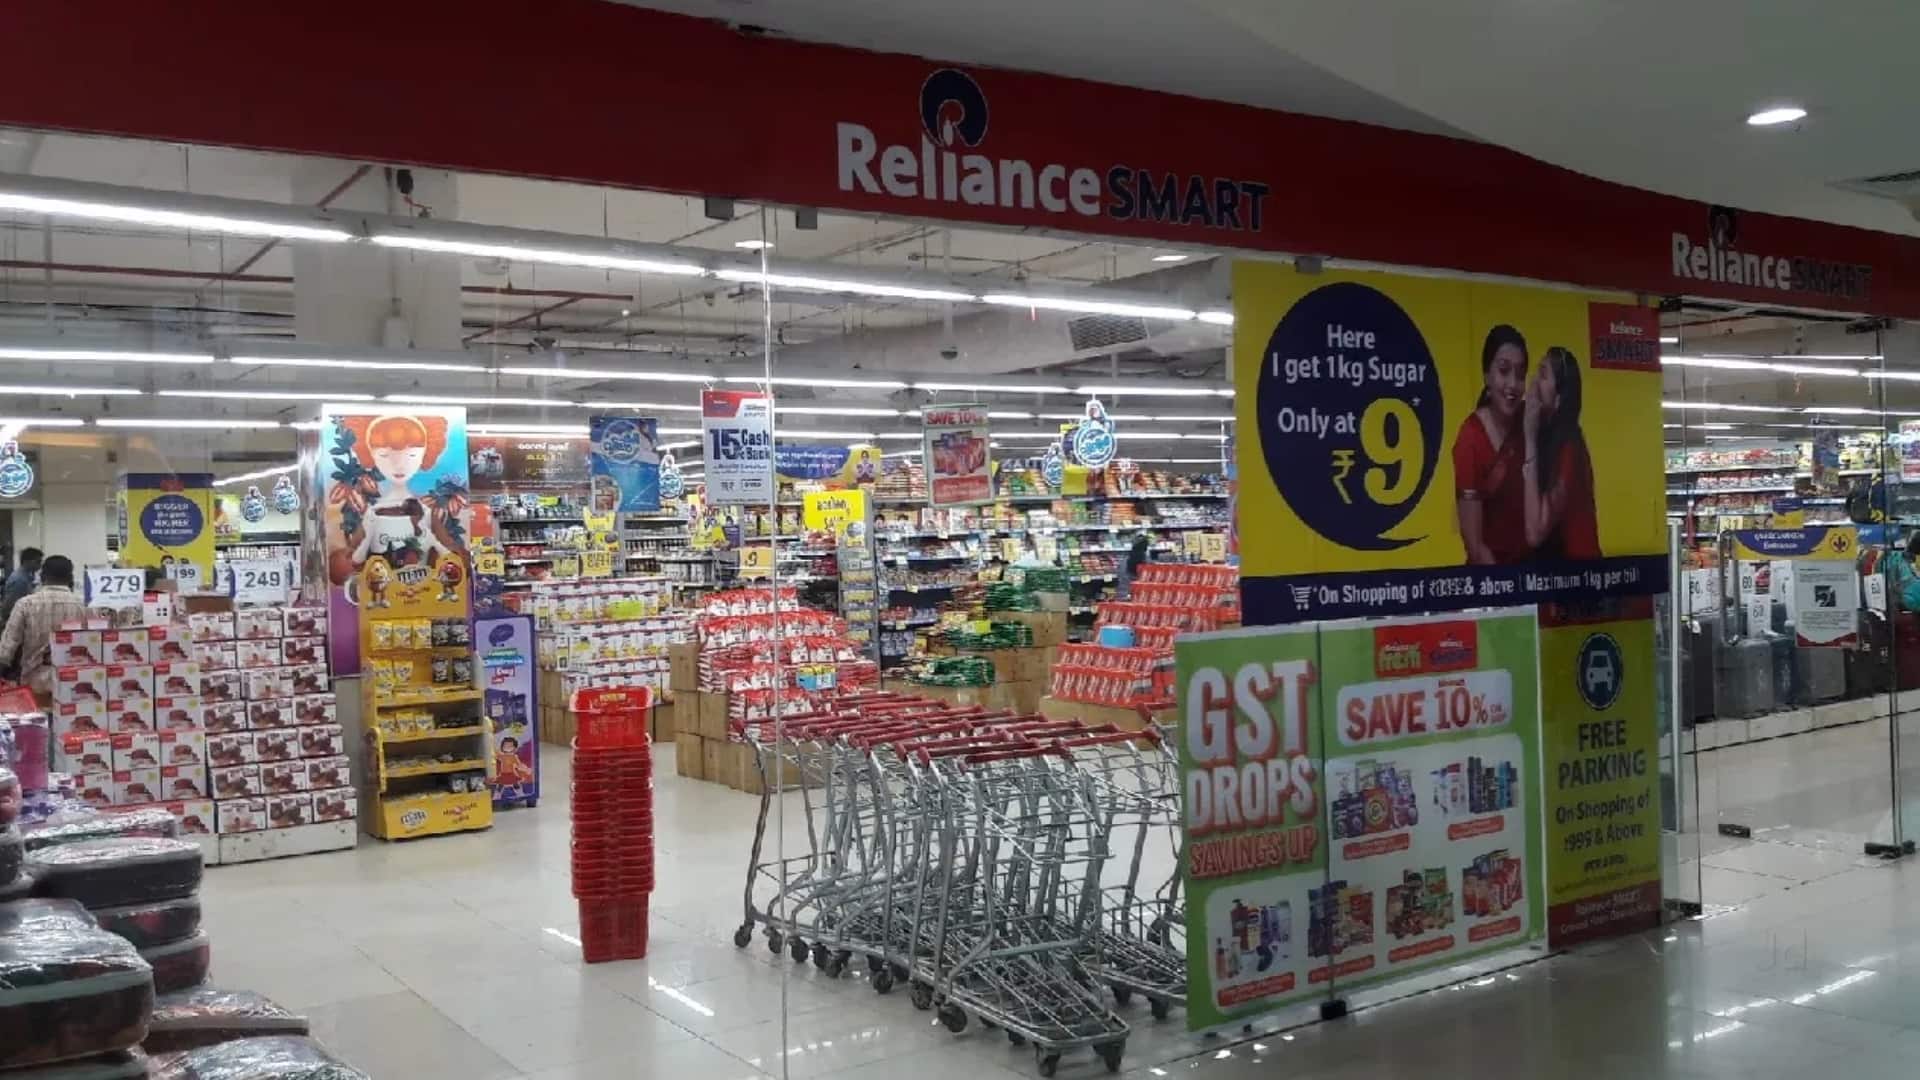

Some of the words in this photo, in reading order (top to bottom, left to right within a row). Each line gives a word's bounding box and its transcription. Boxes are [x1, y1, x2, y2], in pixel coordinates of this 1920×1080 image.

[836, 121, 1101, 215] Reliance
[1107, 165, 1270, 232] SMART
[1672, 232, 1791, 290] Reliance
[1327, 324, 1375, 349] Here
[1272, 353, 1278, 377] I
[1285, 357, 1320, 384] get
[1327, 355, 1364, 387] 1kg
[1368, 358, 1427, 387] Sugar
[741, 429, 769, 446] Cash
[1278, 408, 1331, 440] Only
[1334, 411, 1356, 434] at
[100, 574, 140, 593] 279
[245, 571, 280, 587] 249
[1319, 585, 1339, 605] On
[1343, 581, 1407, 607] Shopping
[1411, 581, 1425, 600] of
[1480, 576, 1515, 595] above
[1526, 573, 1581, 591] Maximum
[1584, 570, 1601, 591] 1kg
[1604, 571, 1622, 590] per
[1186, 660, 1313, 765] GST
[1347, 690, 1426, 740] SAVE
[1578, 720, 1626, 752] FREE
[1558, 749, 1646, 789] PARKING
[1186, 754, 1317, 835] DROPS
[1556, 806, 1574, 824] On
[1577, 792, 1635, 821] Shopping
[1637, 789, 1650, 808] of
[1606, 823, 1644, 844] Above
[1190, 833, 1283, 878] SAVINGS
[1288, 825, 1317, 862] UP
